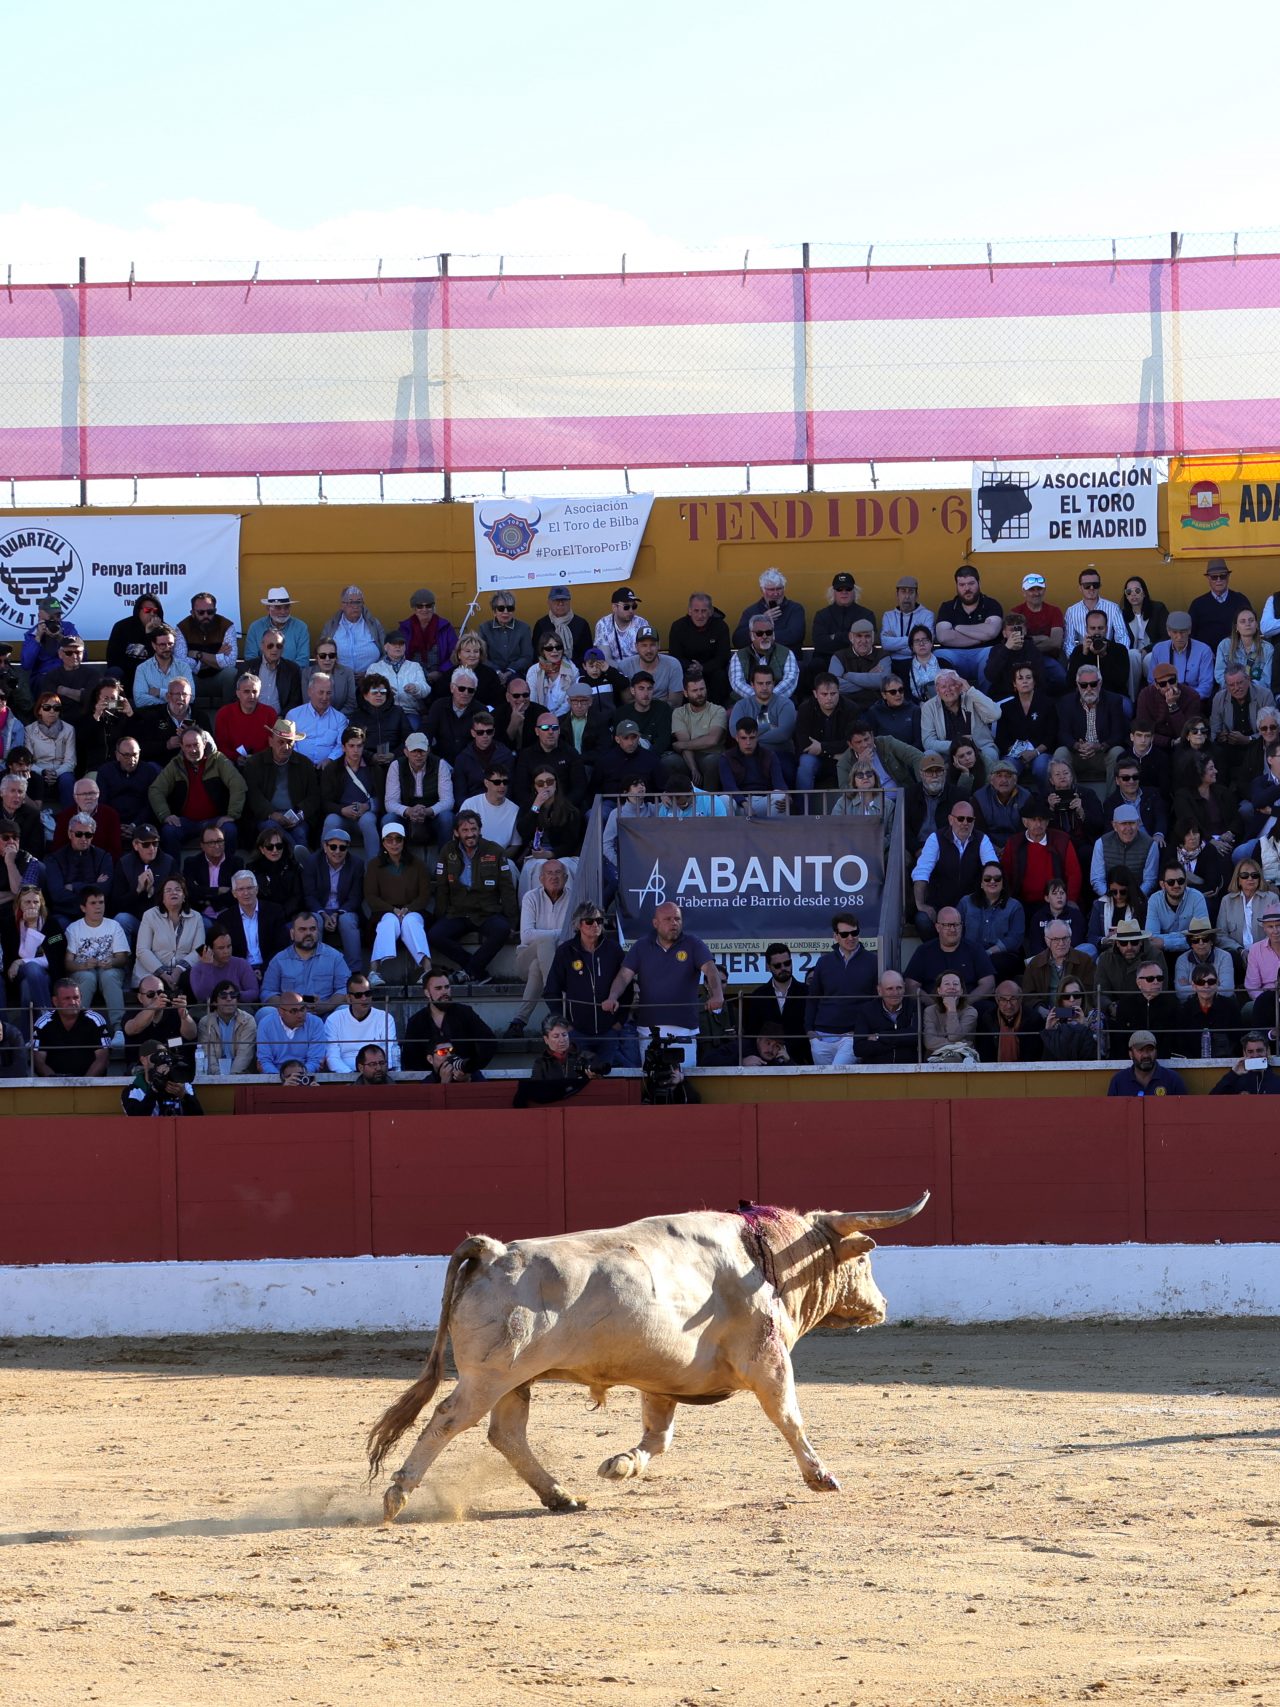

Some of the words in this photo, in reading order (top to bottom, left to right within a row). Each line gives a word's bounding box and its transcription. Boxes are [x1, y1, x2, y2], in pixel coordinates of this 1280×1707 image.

[1042, 465, 1152, 489] ASOCIACIÓN
[564, 500, 629, 515] Asociación
[1061, 494, 1081, 514] EL
[1087, 492, 1135, 513] TORO
[548, 521, 560, 533] El
[564, 520, 591, 532] Toro
[593, 518, 606, 529] de
[608, 515, 640, 528] Bilba
[679, 496, 920, 542] TENDIDO
[940, 495, 968, 535] 6
[1049, 520, 1072, 540] DE
[1077, 518, 1147, 539] MADRID
[0, 531, 66, 558] QUARTELL
[91, 562, 133, 577] Penya
[135, 560, 187, 576] Taurina
[113, 580, 168, 598] Quartell
[676, 854, 869, 894] ABANTO
[675, 895, 729, 908] Taberna
[731, 894, 748, 907] de
[750, 894, 791, 907] Barrio
[792, 893, 831, 907] desde
[833, 894, 865, 907] 1988
[710, 942, 719, 950] DE
[720, 942, 733, 950] LAS
